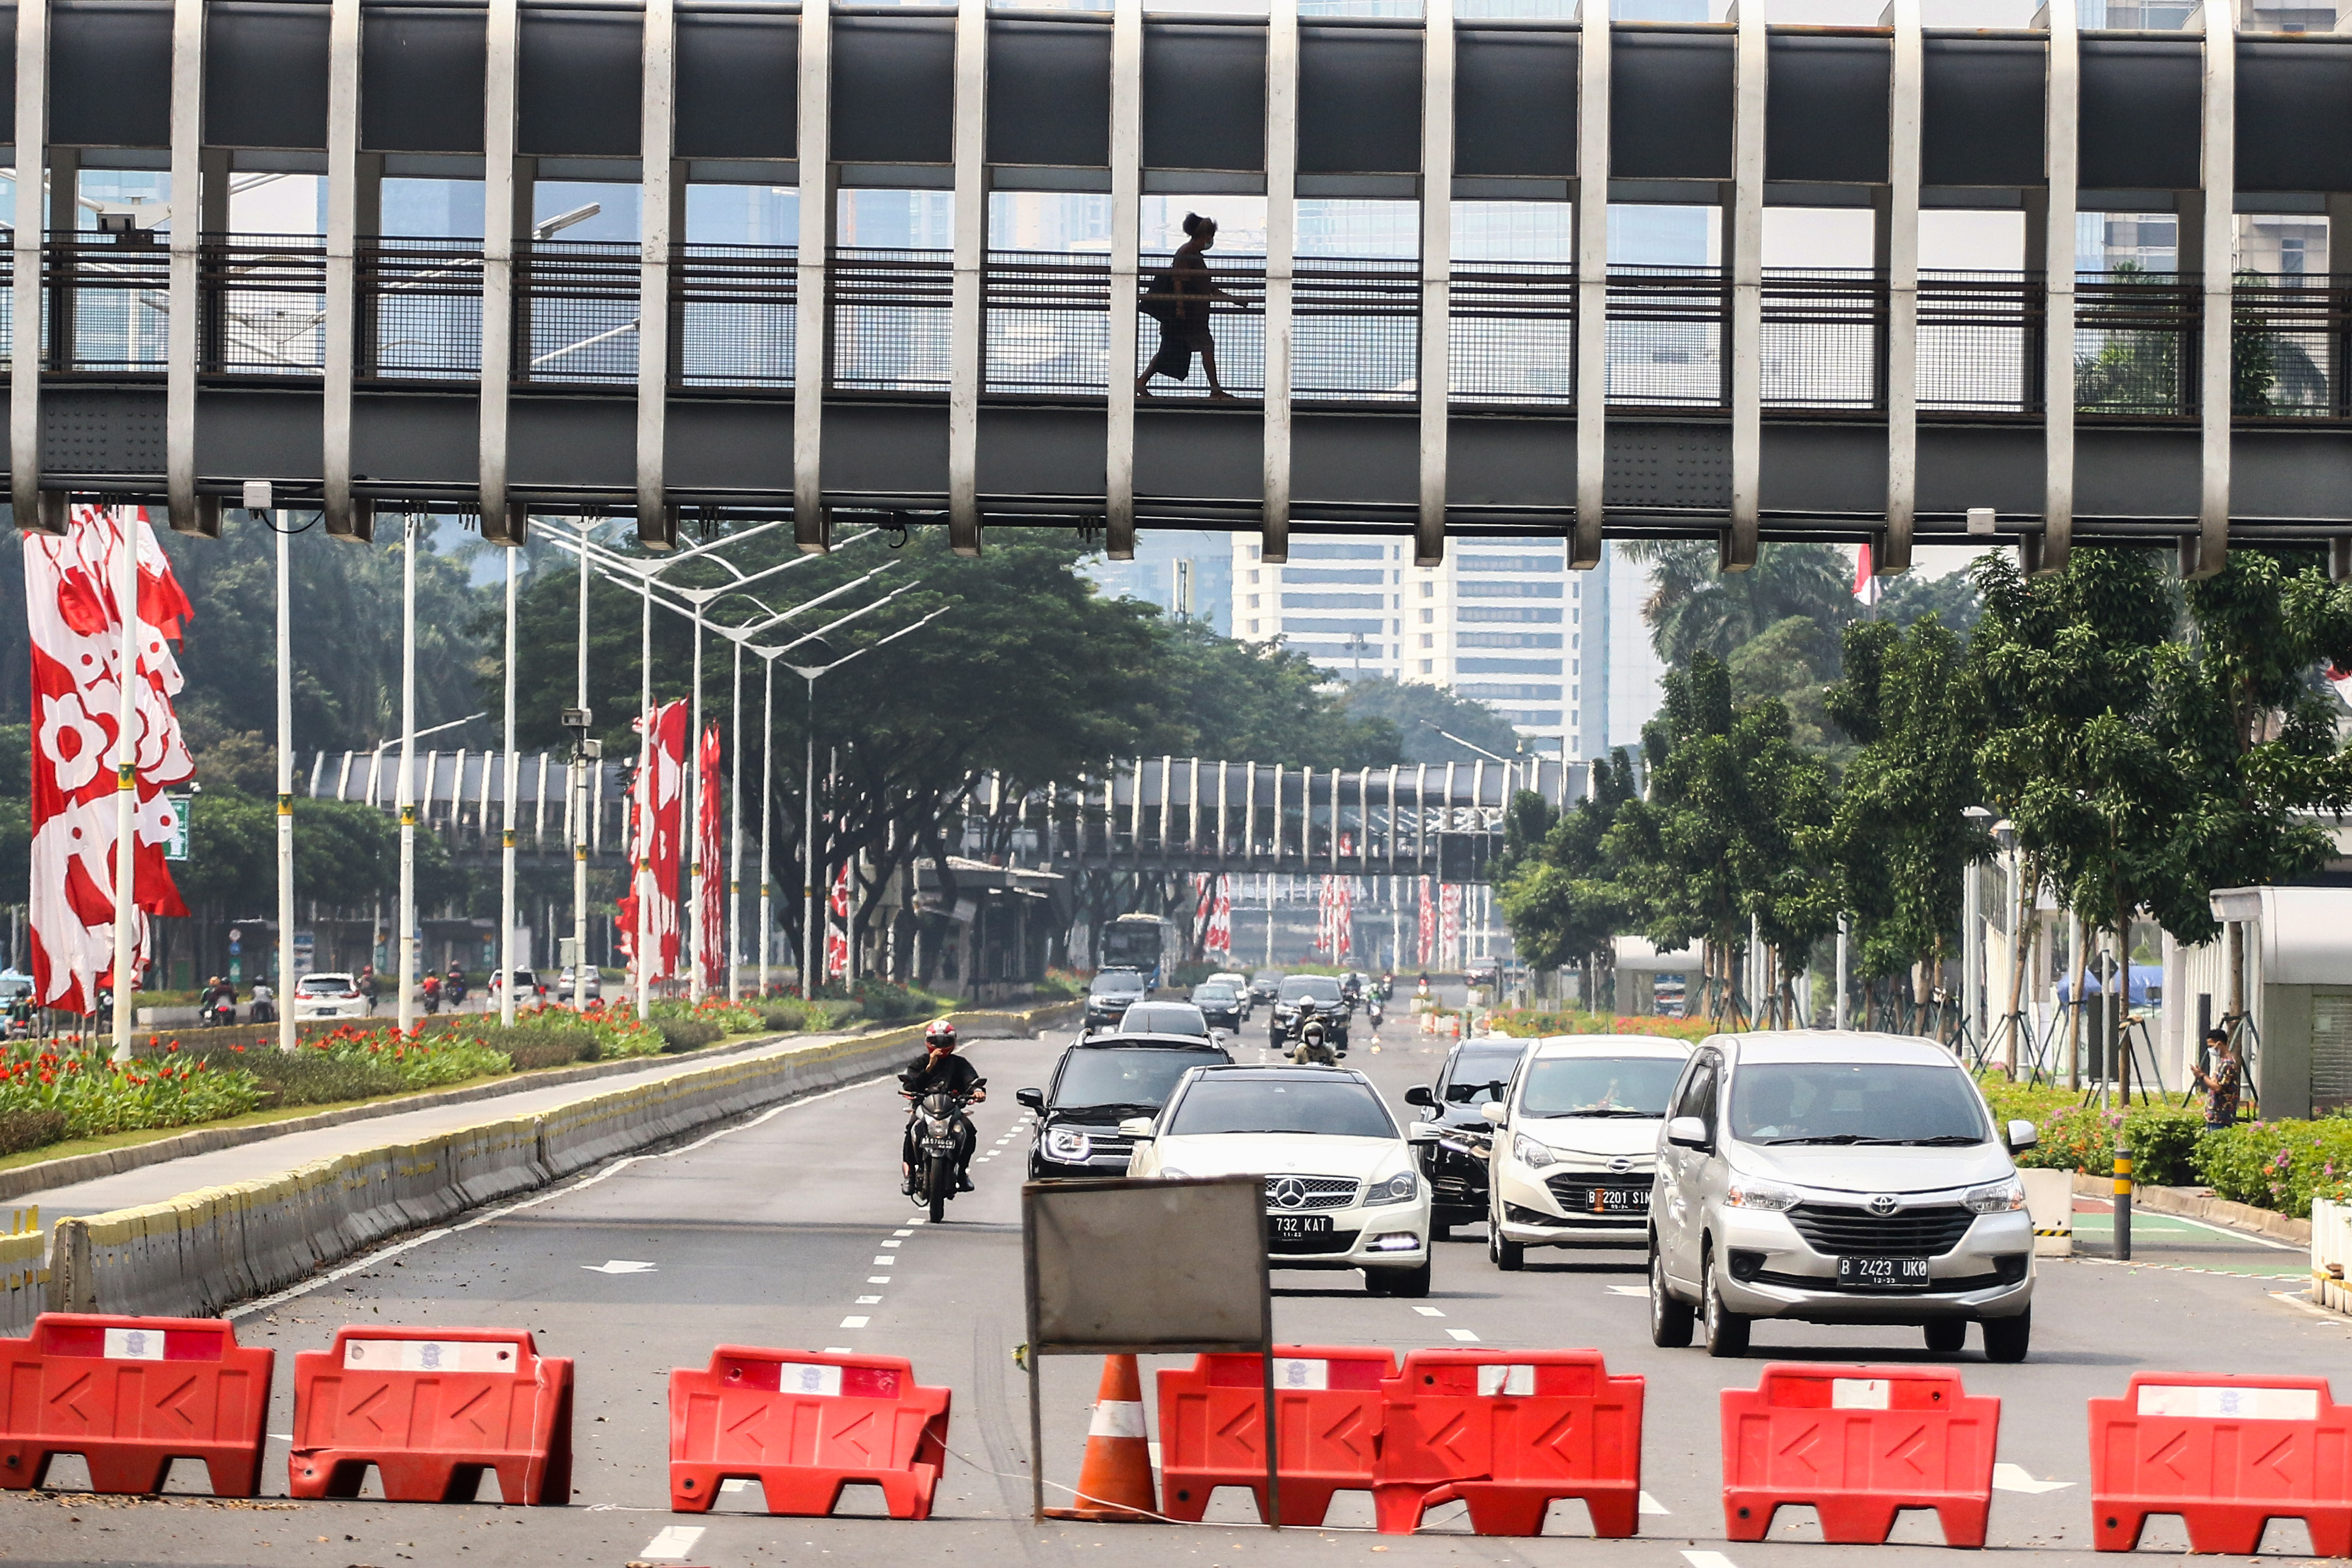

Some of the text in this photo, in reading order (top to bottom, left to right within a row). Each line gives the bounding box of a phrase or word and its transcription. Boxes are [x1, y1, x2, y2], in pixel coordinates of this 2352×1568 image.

[1589, 1191, 1596, 1203] B
[1603, 1191, 1626, 1204] 2201
[1276, 1218, 1326, 1232] 732 KAT
[1841, 1260, 1850, 1274] B
[1860, 1260, 1892, 1276] 2423
